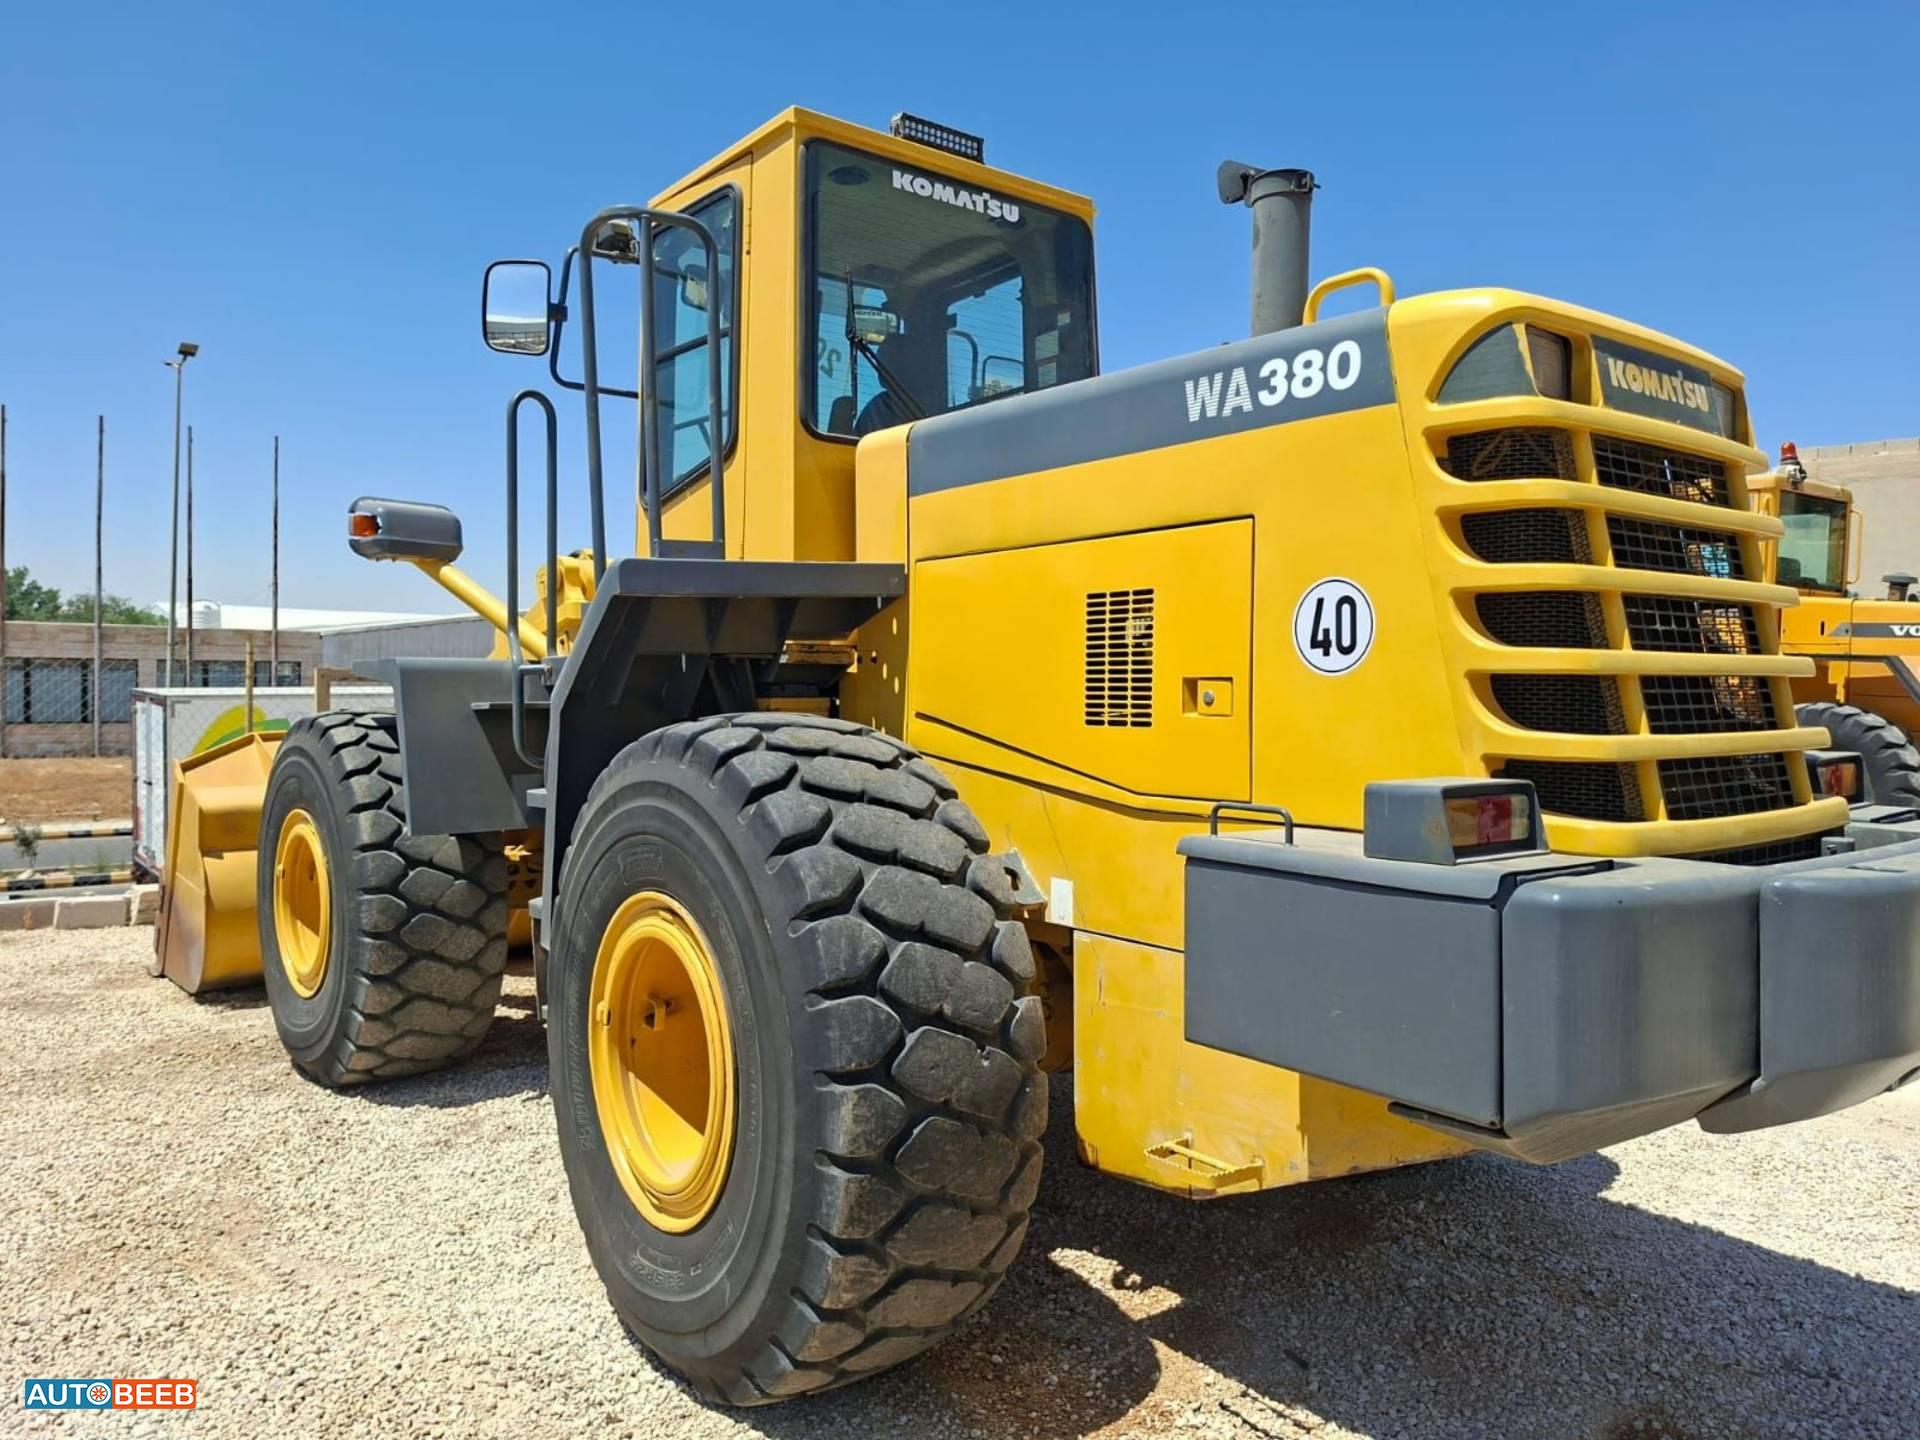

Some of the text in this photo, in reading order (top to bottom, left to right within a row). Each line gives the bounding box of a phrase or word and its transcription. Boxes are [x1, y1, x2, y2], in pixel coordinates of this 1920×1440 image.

[892, 169, 1020, 223] KOMATSU
[1607, 357, 1709, 413] KOMATSU
[1309, 595, 1358, 656] 40
